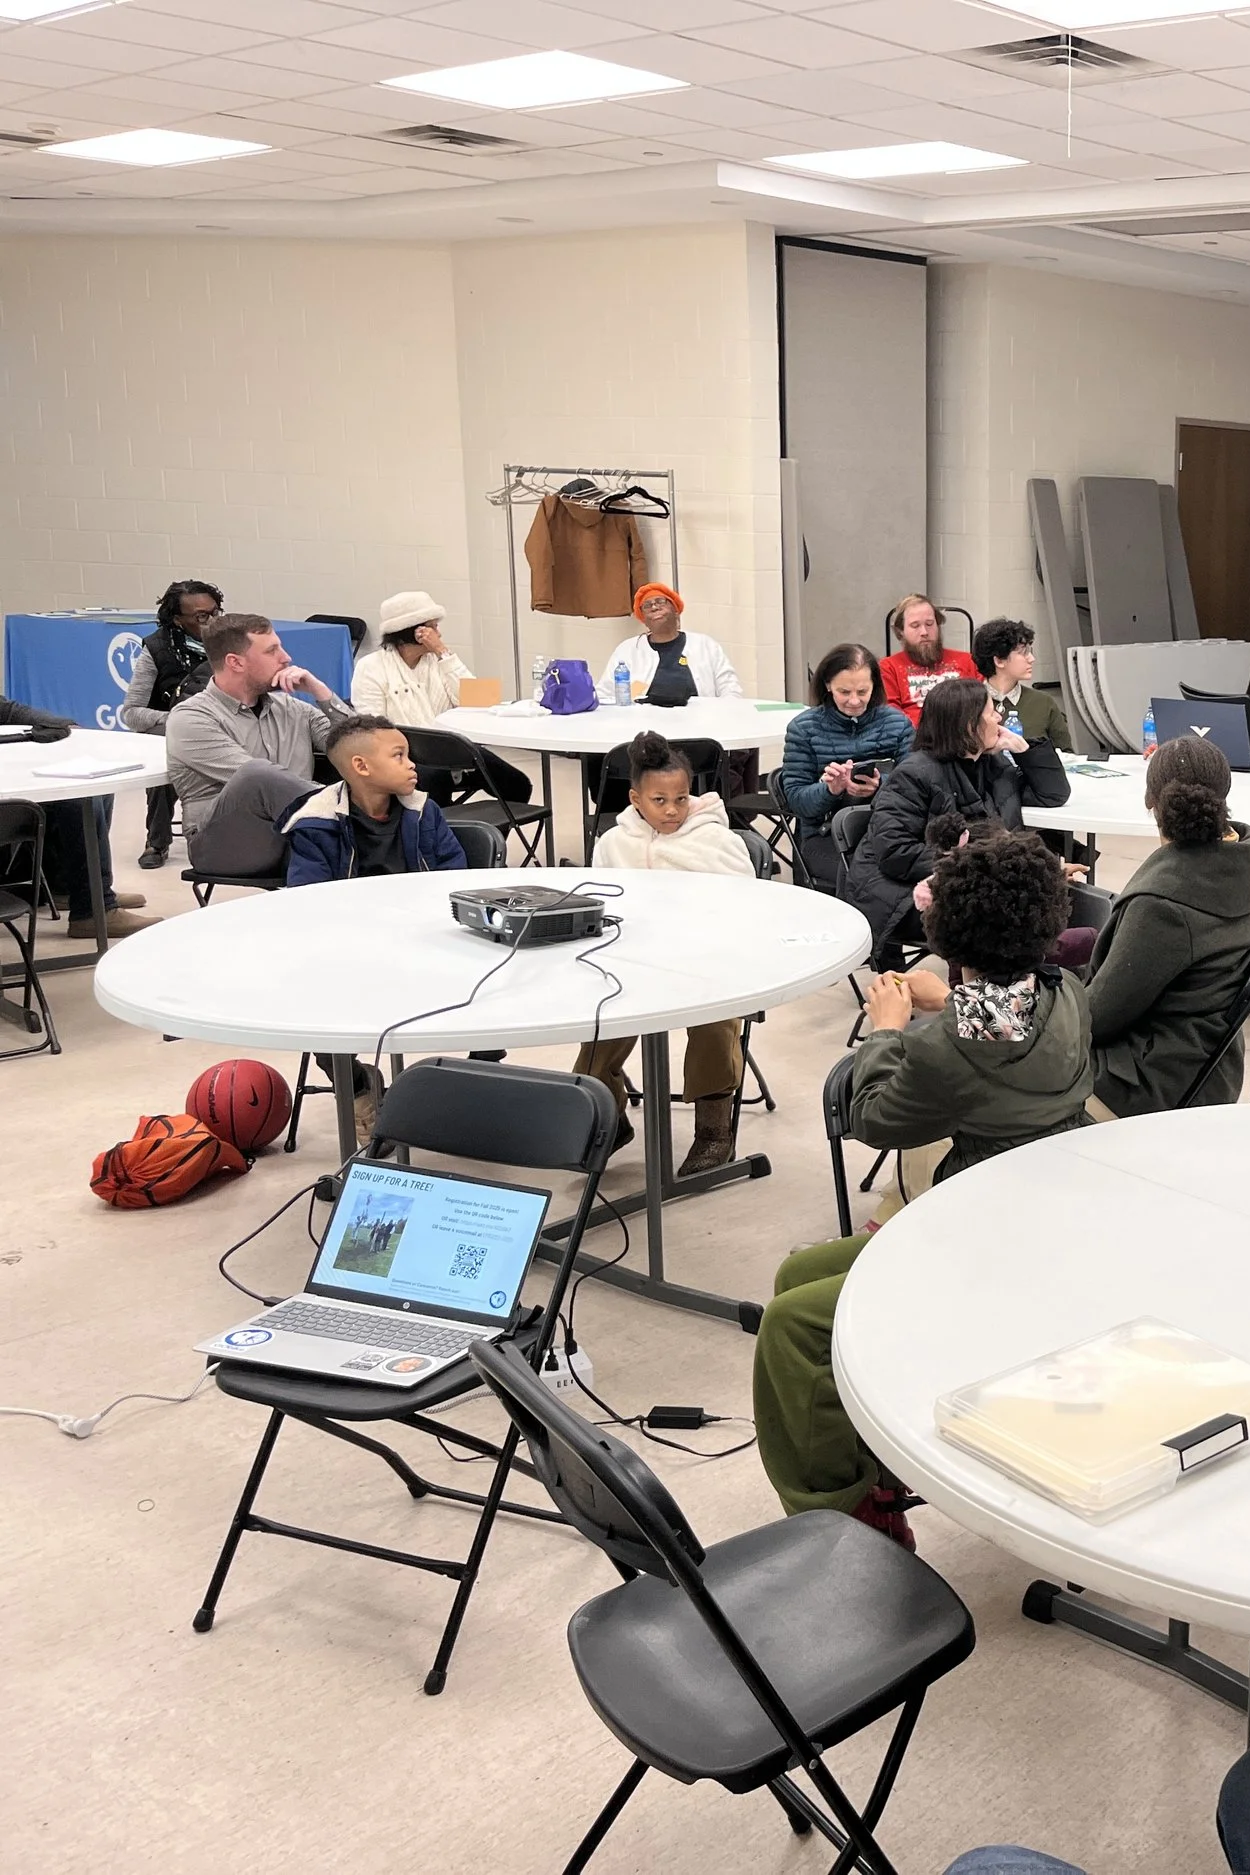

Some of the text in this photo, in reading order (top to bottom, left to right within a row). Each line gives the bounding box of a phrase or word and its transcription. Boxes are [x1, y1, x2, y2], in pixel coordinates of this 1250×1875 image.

[352, 1170, 434, 1192] SIGN UP FOR A TREE!
